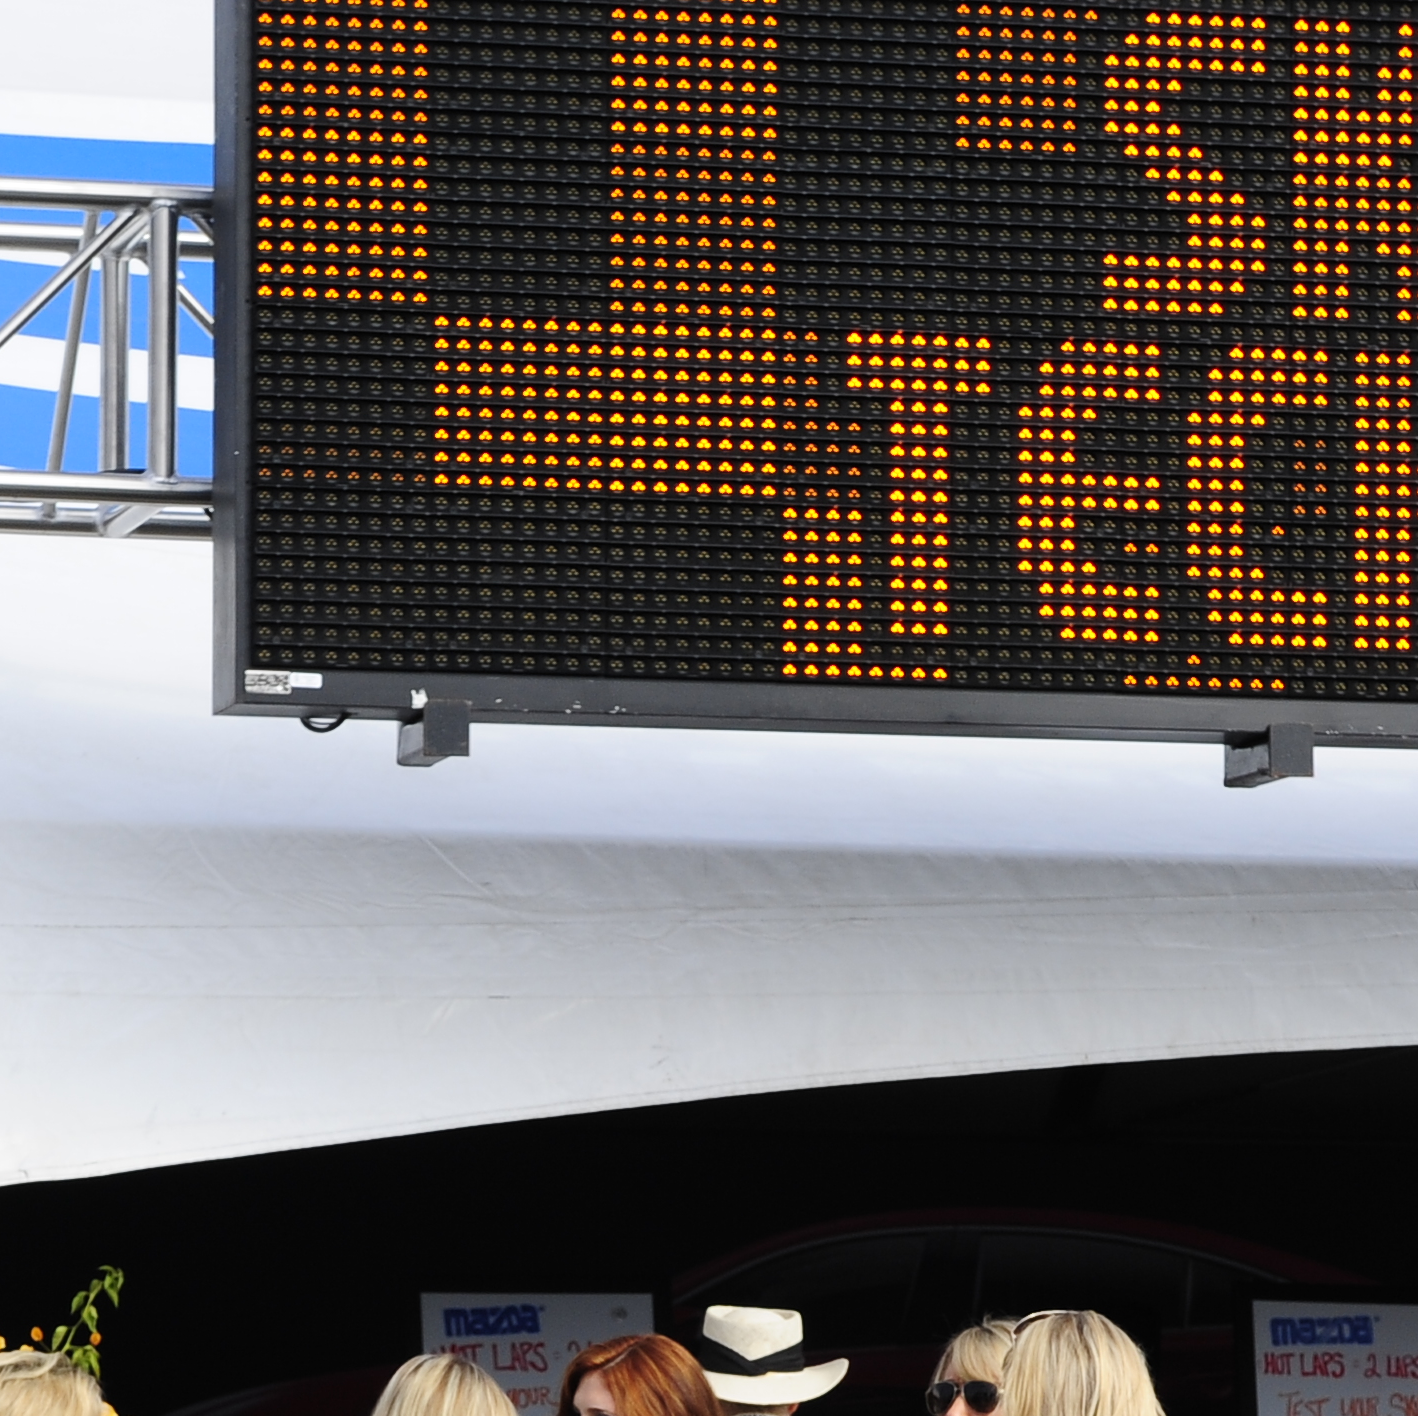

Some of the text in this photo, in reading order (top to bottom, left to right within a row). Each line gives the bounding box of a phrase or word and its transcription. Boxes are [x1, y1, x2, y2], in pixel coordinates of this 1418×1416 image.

[1263, 1352, 1296, 1376] HOT
[1299, 1353, 1346, 1379] LAPS
[1364, 1354, 1382, 1379] 2
